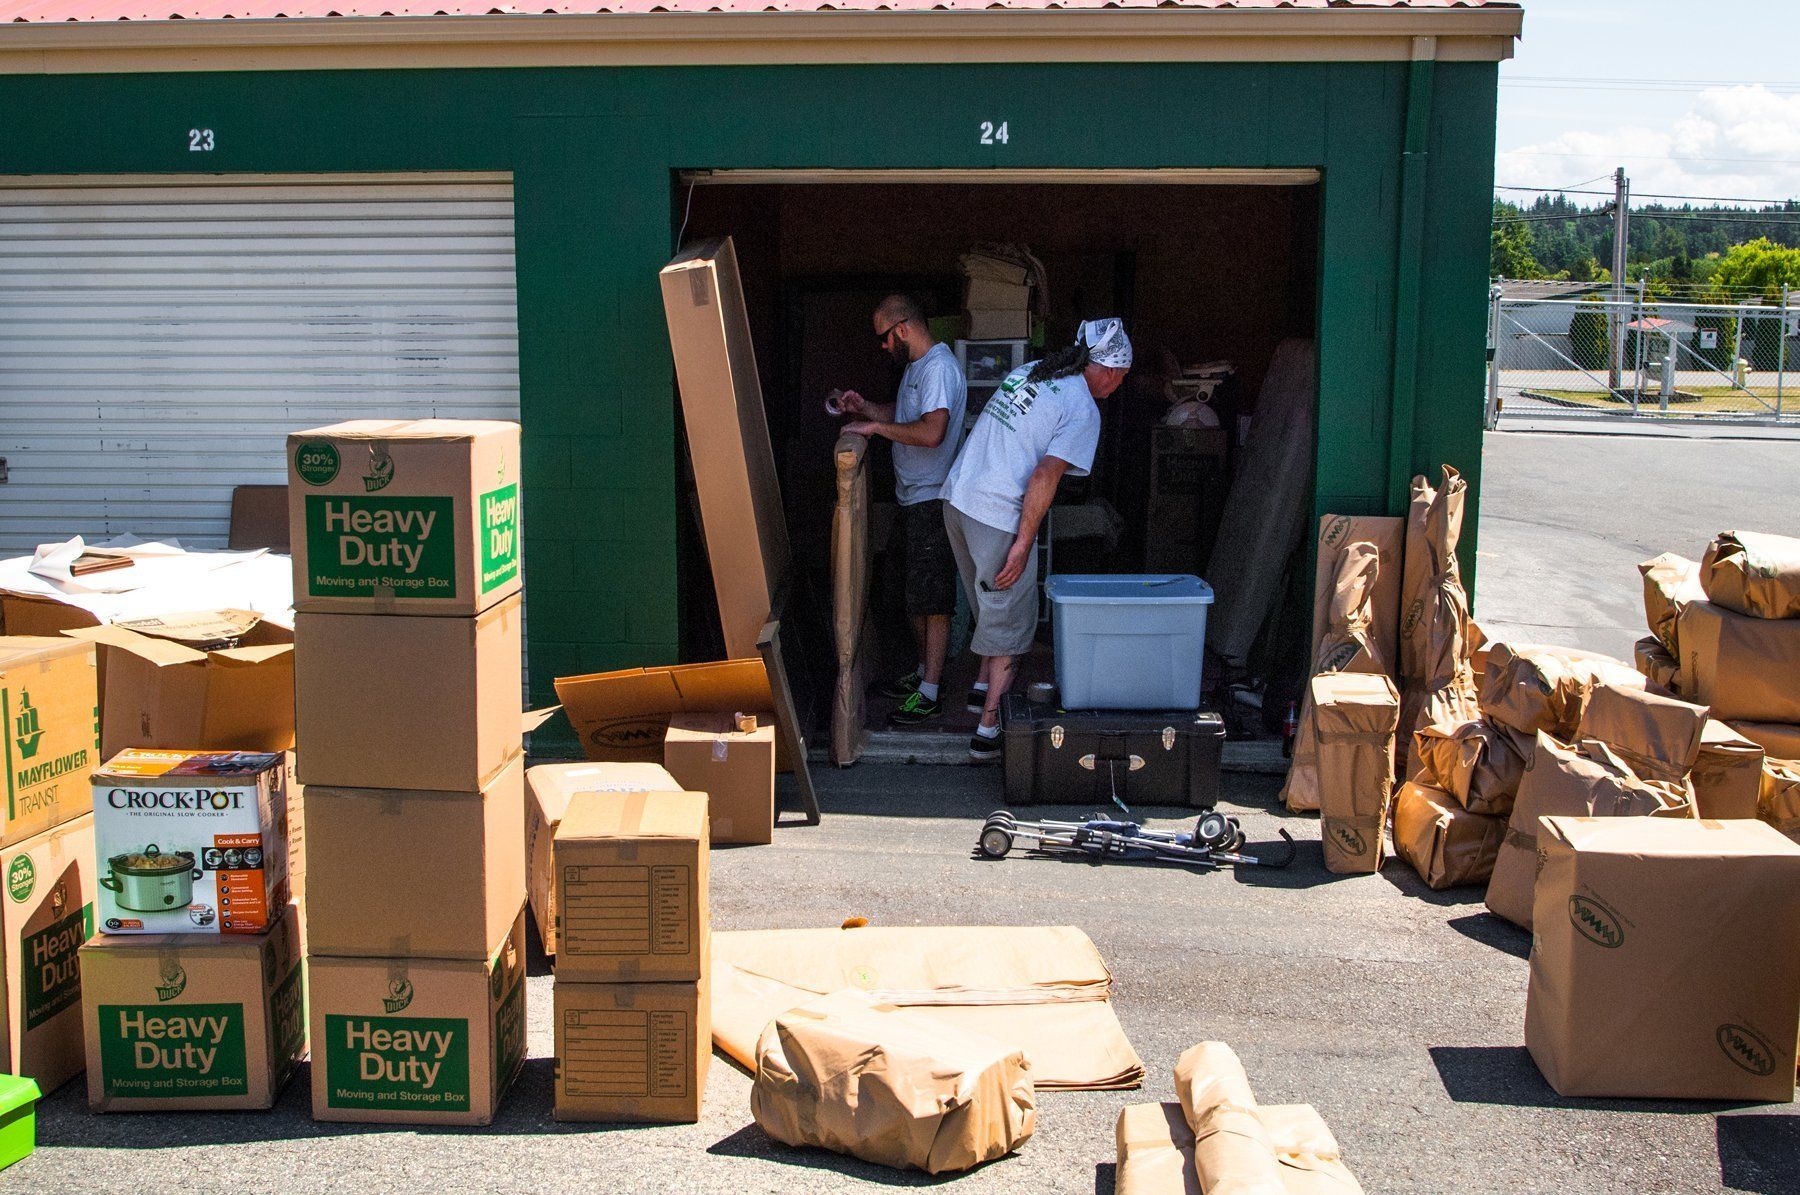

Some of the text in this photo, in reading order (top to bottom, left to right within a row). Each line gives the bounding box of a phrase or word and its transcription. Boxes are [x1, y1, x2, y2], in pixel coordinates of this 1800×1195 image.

[188, 128, 215, 151] 23
[980, 121, 1009, 144] 24
[303, 453, 334, 465] 30%
[366, 476, 390, 490] DUCK
[325, 502, 436, 540] Heavy
[486, 496, 516, 528] Heavy
[340, 536, 423, 573] Duty
[491, 526, 513, 559] Duty
[316, 576, 449, 588] Moving and Storage Box
[18, 749, 88, 788] MAYFLOWER
[20, 784, 58, 816] TRANSIT
[11, 878, 34, 892] Stronger
[12, 866, 32, 884] 30%
[33, 918, 86, 966] Heavy
[42, 952, 80, 993] Duty
[160, 985, 182, 1000] DUCK
[386, 1000, 410, 1012] DUCK
[120, 1010, 228, 1044] Heavy
[346, 1021, 453, 1059] Heavy
[134, 1042, 217, 1074] Duty
[360, 1052, 441, 1089] Duty
[112, 1077, 242, 1089] Moving and Storage Box
[337, 1089, 465, 1102] Moving and Storage Box
